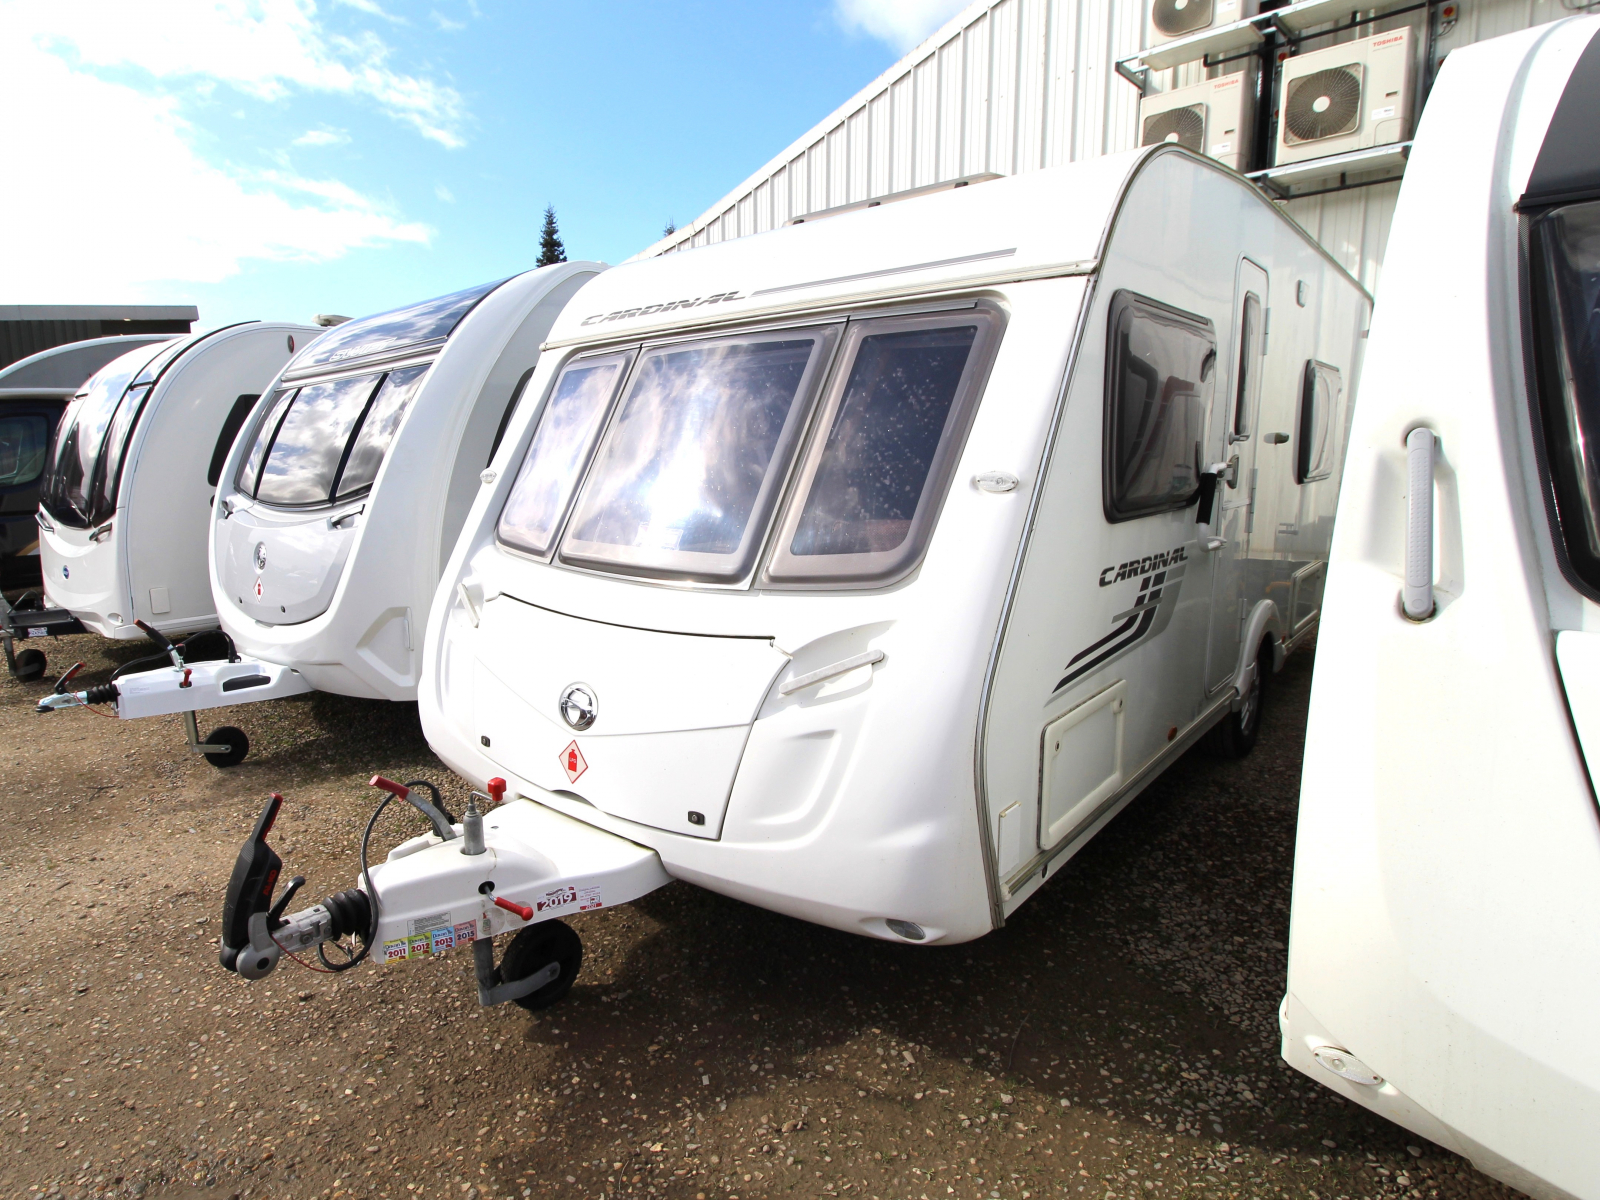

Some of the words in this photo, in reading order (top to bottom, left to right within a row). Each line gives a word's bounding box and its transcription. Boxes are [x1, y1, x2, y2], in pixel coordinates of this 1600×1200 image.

[1373, 35, 1404, 47] TOSHIBA
[1214, 79, 1239, 89] TOSHIBA
[580, 291, 746, 326] CARDINAL
[1099, 546, 1188, 587] CARDINAL
[541, 892, 573, 911] 2019
[457, 930, 475, 941] 2015
[434, 936, 454, 947] 2013
[388, 948, 406, 958] 2011
[411, 942, 430, 953] 2012
